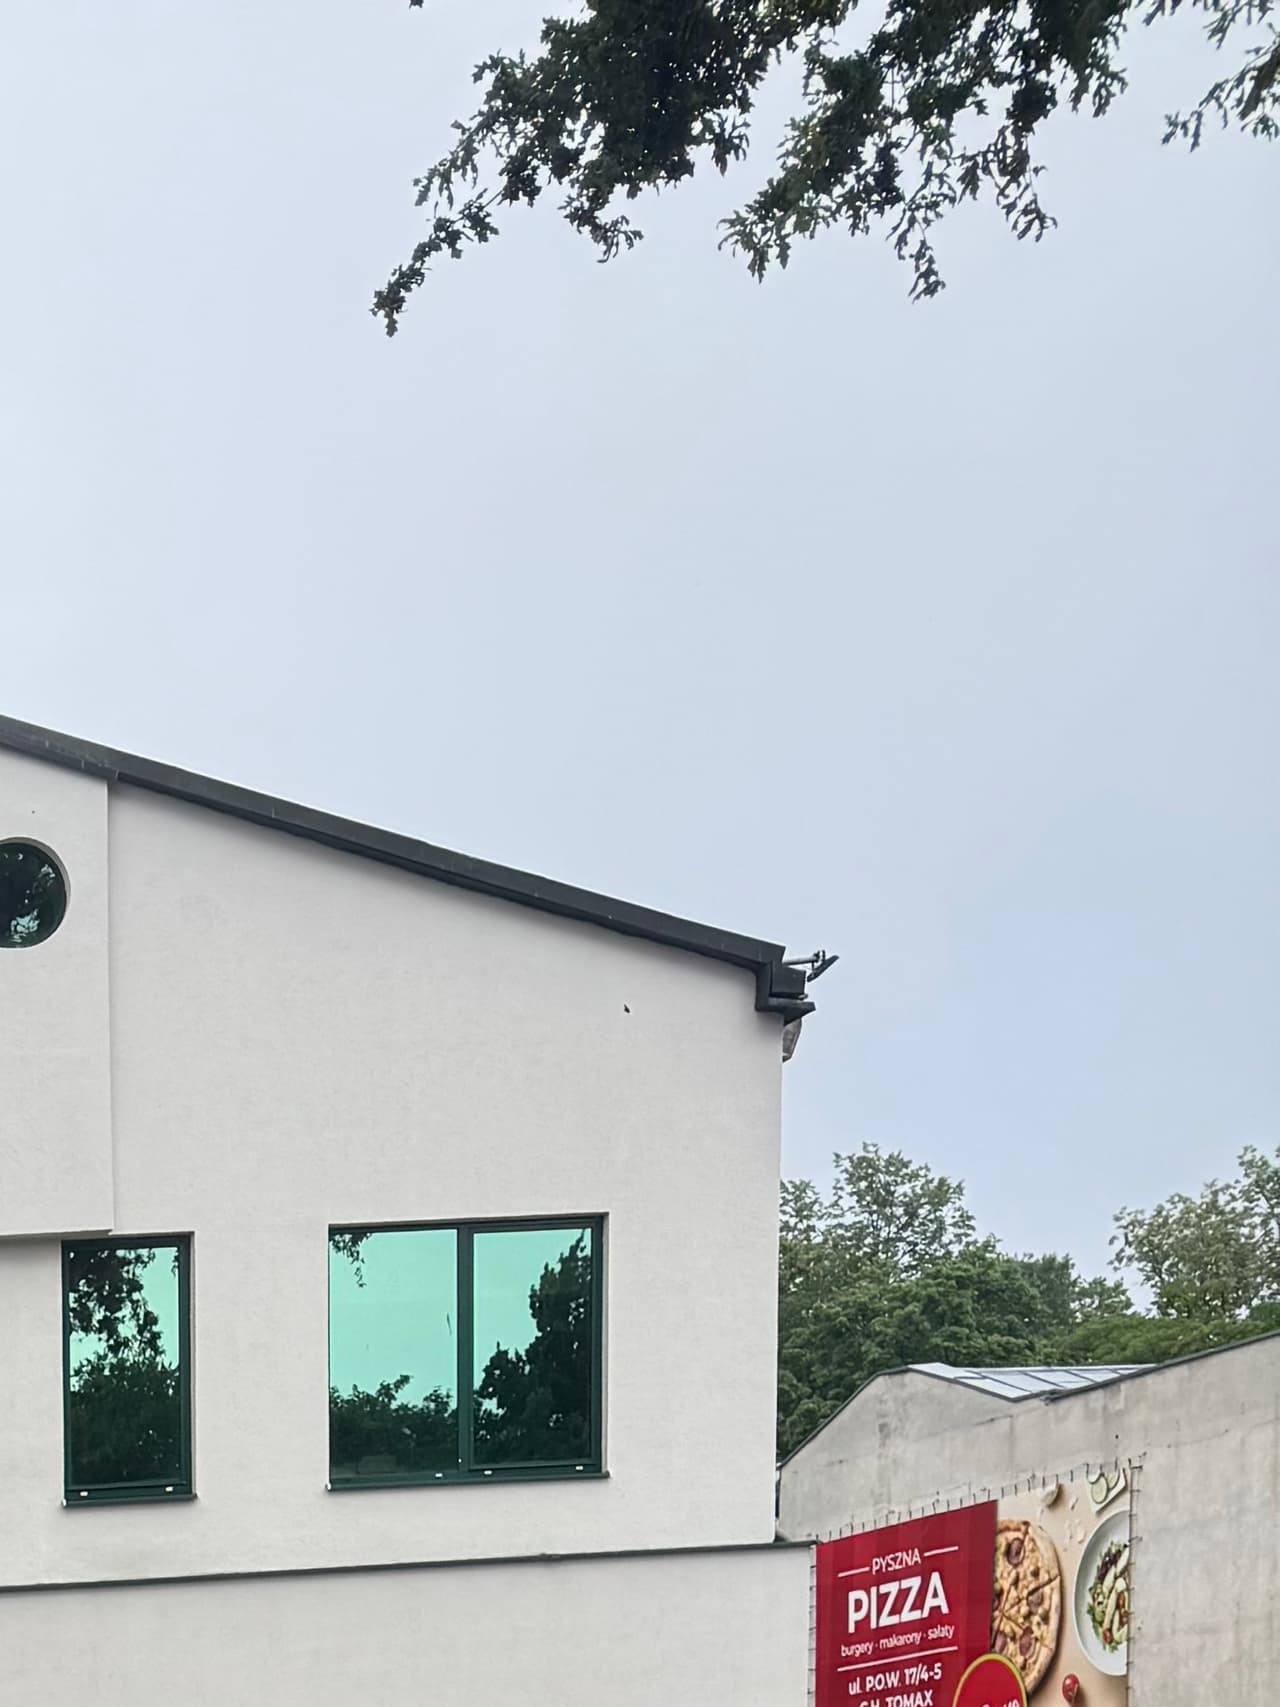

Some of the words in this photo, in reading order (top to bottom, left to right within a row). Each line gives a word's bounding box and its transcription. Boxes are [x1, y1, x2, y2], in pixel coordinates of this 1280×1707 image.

[872, 1548, 922, 1575] PYSZNA
[848, 1571, 950, 1634] PIZZA
[841, 1642, 874, 1658] burgery
[879, 1631, 922, 1650] makarony
[848, 1677, 863, 1695] ul.
[904, 1662, 942, 1686] 17/4-5
